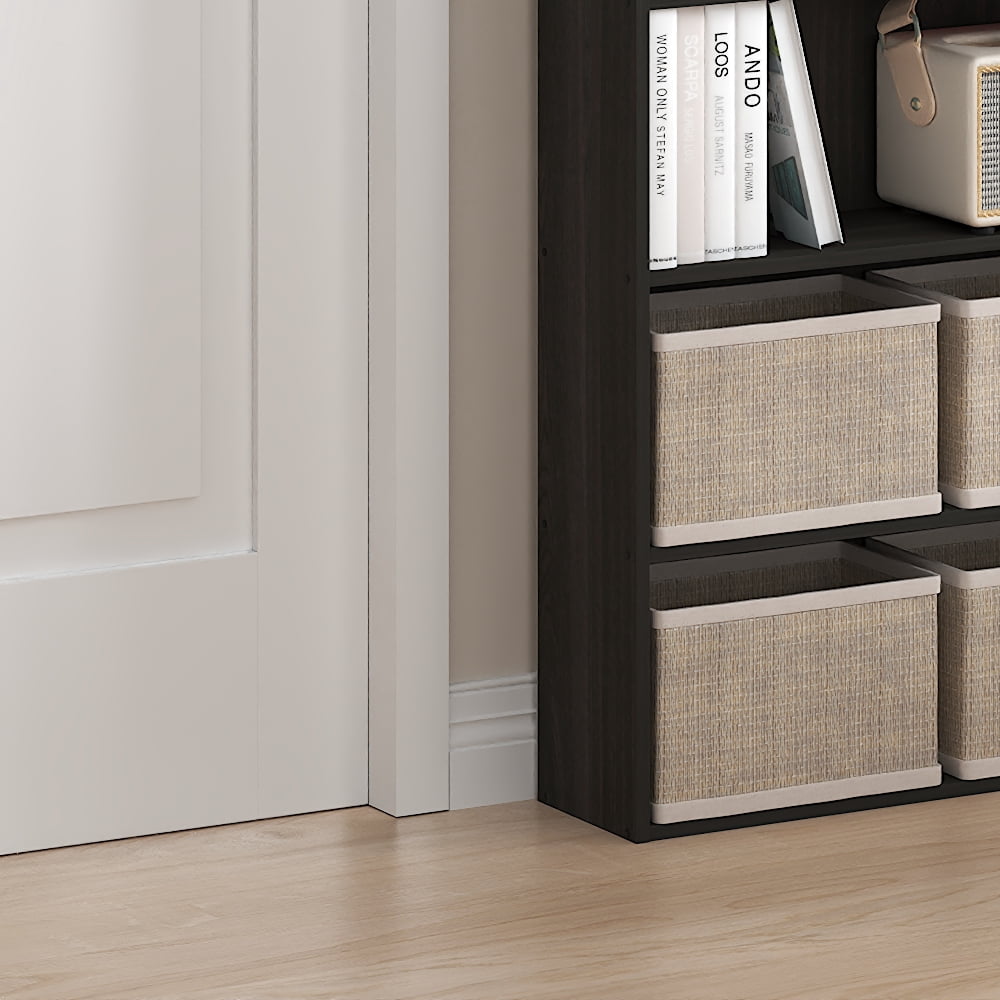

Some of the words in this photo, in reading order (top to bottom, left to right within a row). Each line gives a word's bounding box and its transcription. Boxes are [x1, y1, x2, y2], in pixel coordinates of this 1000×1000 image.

[656, 34, 668, 83] WOMAN
[714, 32, 729, 79] LOOS
[744, 44, 761, 109] ANDO
[656, 88, 668, 121] ONLY
[714, 95, 725, 132] AUGUST
[656, 125, 667, 169] STEFAN
[656, 173, 666, 197] MAY
